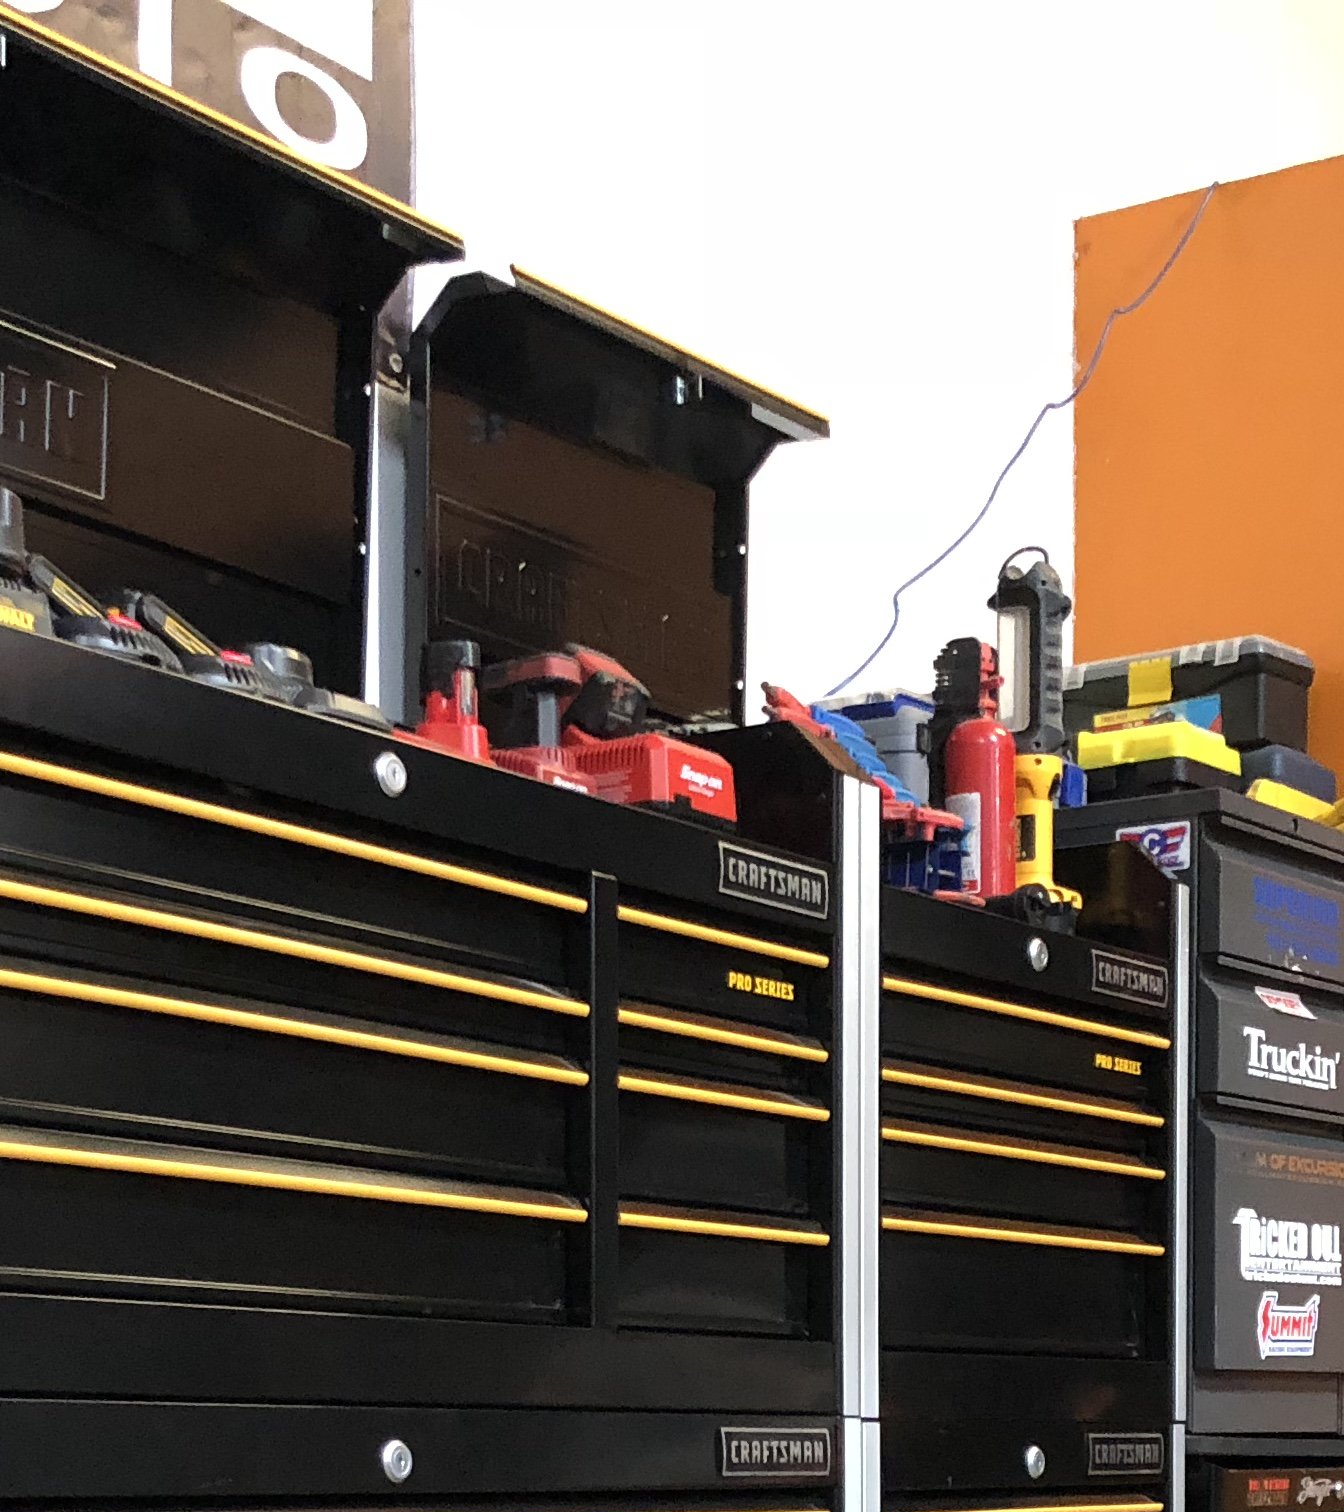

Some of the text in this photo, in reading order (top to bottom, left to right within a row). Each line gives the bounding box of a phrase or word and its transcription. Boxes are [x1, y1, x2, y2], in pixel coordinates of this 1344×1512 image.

[727, 856, 822, 906] CRAFTSMAN
[727, 970, 794, 1001] PRO SERIES
[1098, 960, 1164, 997] CRAFTSMAN
[1095, 1052, 1113, 1070] PRO
[1243, 1025, 1340, 1090] Truckin'
[1261, 1299, 1314, 1343] SUMMIT
[730, 1440, 824, 1465] CRAFTSMAN
[1094, 1443, 1160, 1466] CRAFTSMAN
